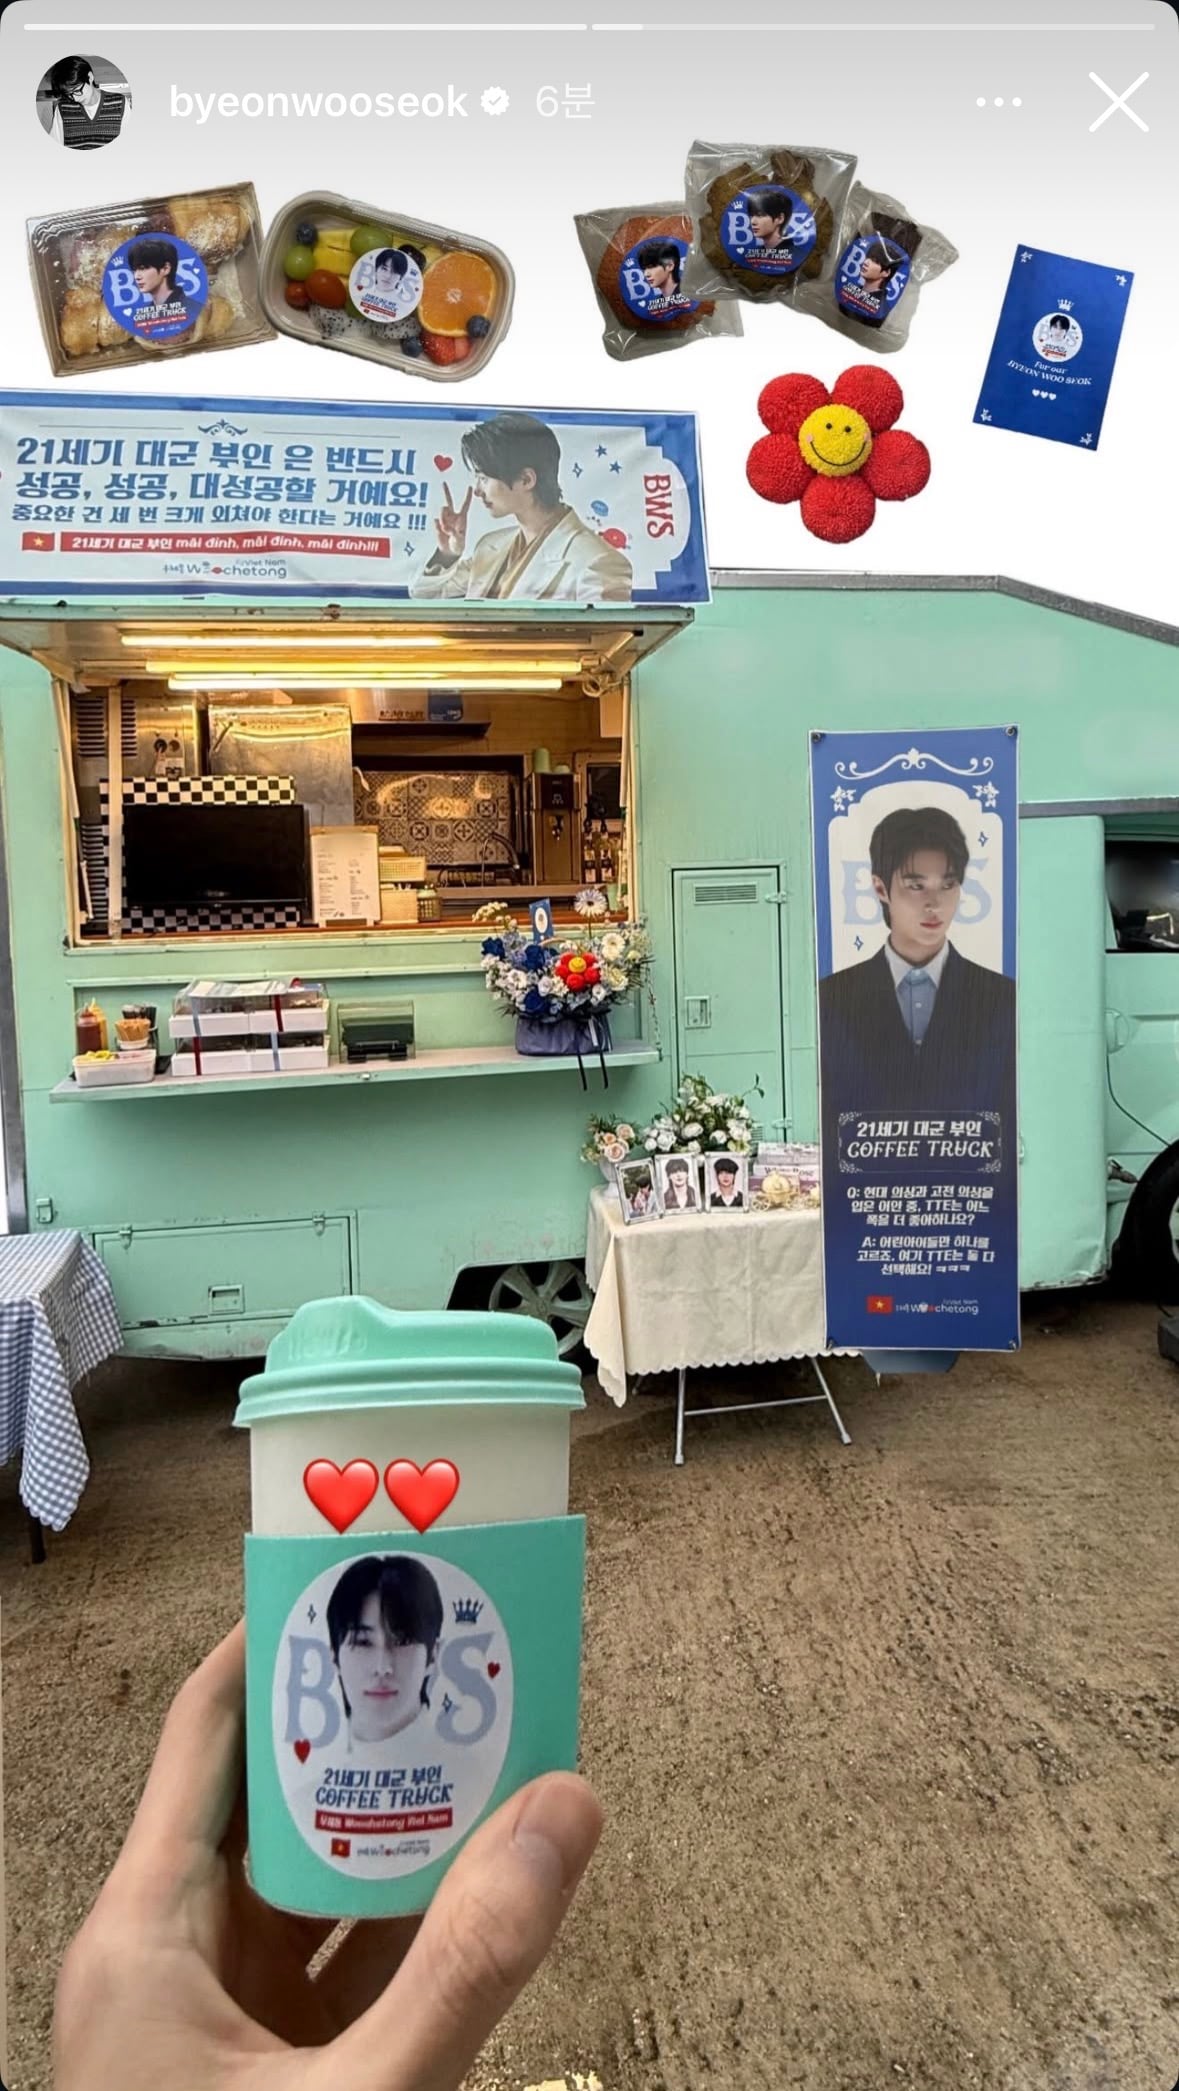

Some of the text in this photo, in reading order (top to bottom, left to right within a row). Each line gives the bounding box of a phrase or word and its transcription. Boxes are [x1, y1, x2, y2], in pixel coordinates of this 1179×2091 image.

[16, 437, 416, 475] 21세기 대군 부인 은 반드시
[16, 472, 428, 508] 성공, 성공, 대성공할 거예요!
[12, 504, 427, 530] 중요한 건 세 번 크게 외쳐야 한다는 거예요 !!!
[644, 475, 674, 538] BWS
[72, 536, 114, 549] 21세기
[857, 1120, 982, 1137] 21세기 대군 부인
[848, 1140, 994, 1158] COFFEE TRUCK
[893, 1214, 905, 1226] 더
[862, 1236, 876, 1248] A:
[323, 1767, 371, 1788] 21세기
[412, 1764, 442, 1786] 부인
[315, 1783, 454, 1809] COFFEE TRUCK
